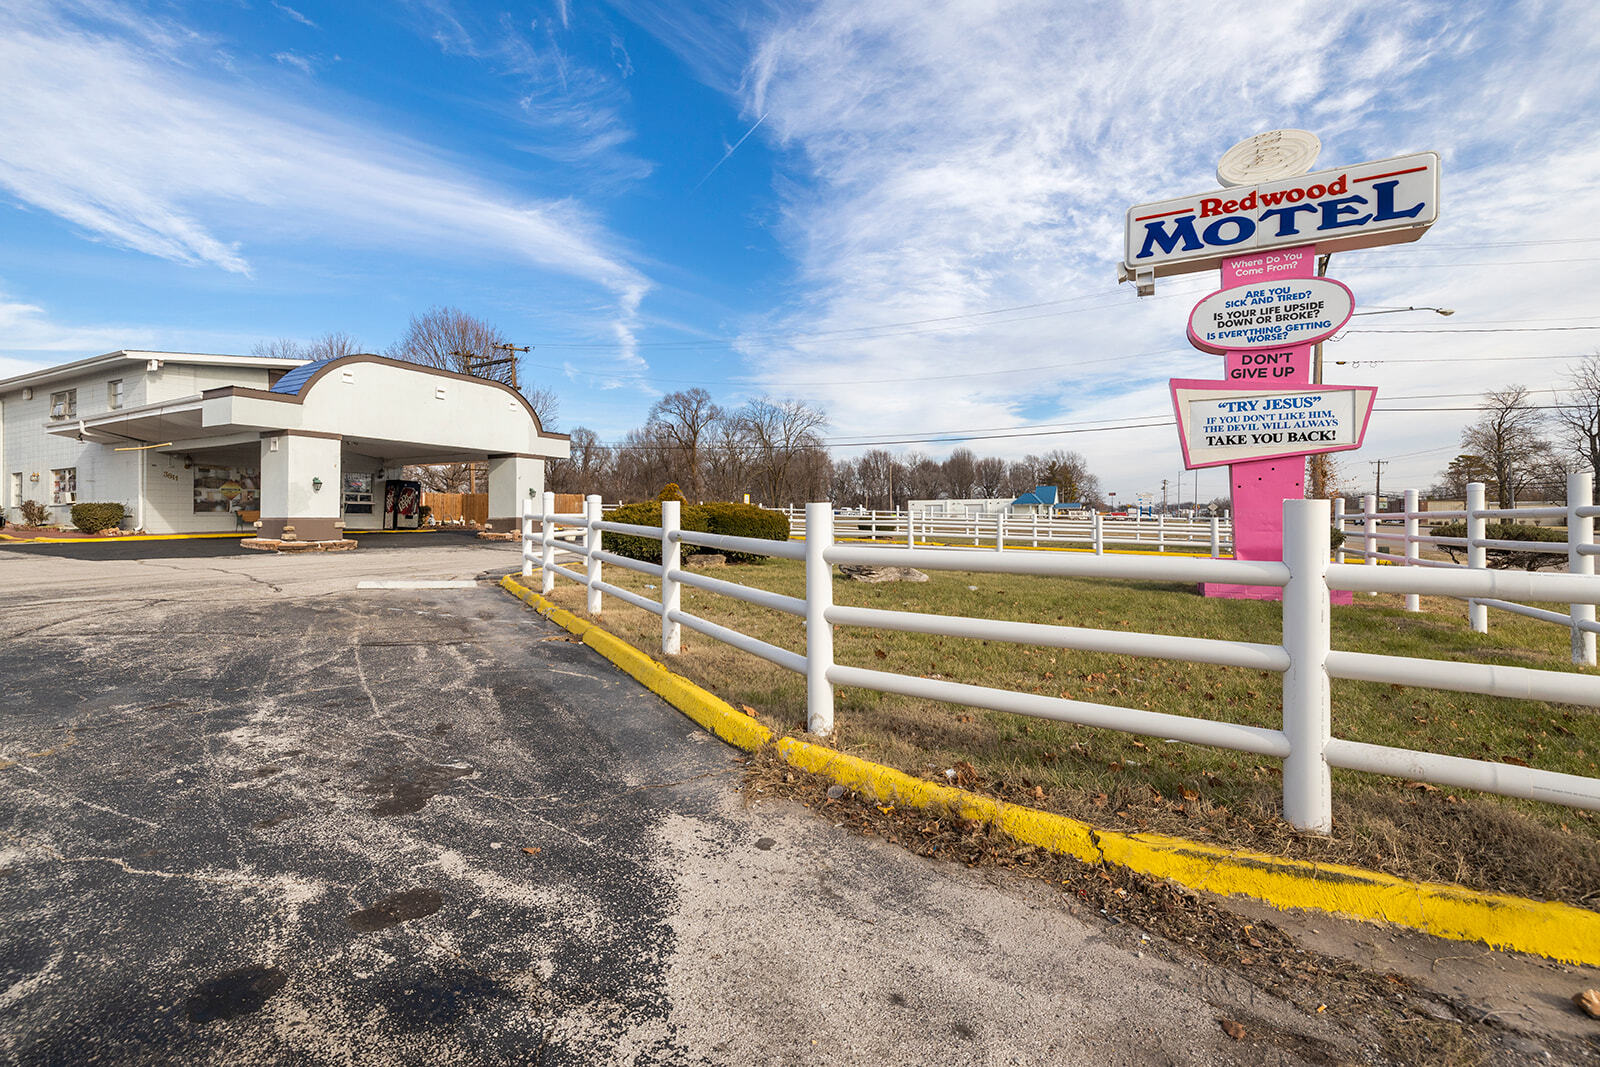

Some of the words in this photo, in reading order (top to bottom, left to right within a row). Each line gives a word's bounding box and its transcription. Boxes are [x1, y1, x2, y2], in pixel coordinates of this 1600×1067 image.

[1200, 174, 1348, 218] Redwood
[1136, 180, 1425, 258] MOTEL
[1231, 259, 1263, 269] Where
[1266, 256, 1280, 264] Do
[1283, 253, 1303, 261] You
[1235, 268, 1264, 277] Come
[1267, 261, 1298, 273] From?
[1224, 299, 1247, 308] SICK
[1250, 296, 1274, 305] AND
[1277, 290, 1312, 302] TIRED?
[1245, 290, 1265, 299] ARE
[1268, 287, 1290, 295] YOU
[1213, 312, 1223, 320] IS
[1227, 309, 1256, 319] YOUR
[1260, 306, 1280, 315] LIFE
[1284, 301, 1324, 312] UPSIDE
[1217, 318, 1252, 328] DOWN
[1256, 316, 1271, 324] OR
[1275, 309, 1320, 322] BROKE?
[1207, 332, 1216, 340] IS
[1218, 325, 1282, 339] EVERYTHING
[1285, 320, 1331, 332] GETTING
[1247, 331, 1288, 343] WORSE?
[1242, 352, 1293, 365] DON'T
[1231, 367, 1267, 379] GIVE
[1273, 366, 1295, 377] UP
[1217, 400, 1259, 412] "TRY
[1262, 396, 1322, 410] JESUS"
[1243, 413, 1275, 422] DON'T
[1279, 411, 1305, 420] LIKE
[1309, 410, 1335, 419] HIM,
[1203, 425, 1224, 433] THE
[1227, 423, 1259, 432] DEVIL
[1262, 422, 1291, 430] WILL
[1294, 419, 1339, 429] ALWAYS
[1206, 434, 1247, 446] TAKE
[1251, 433, 1283, 444] YOU
[1287, 430, 1336, 442] BACK!
